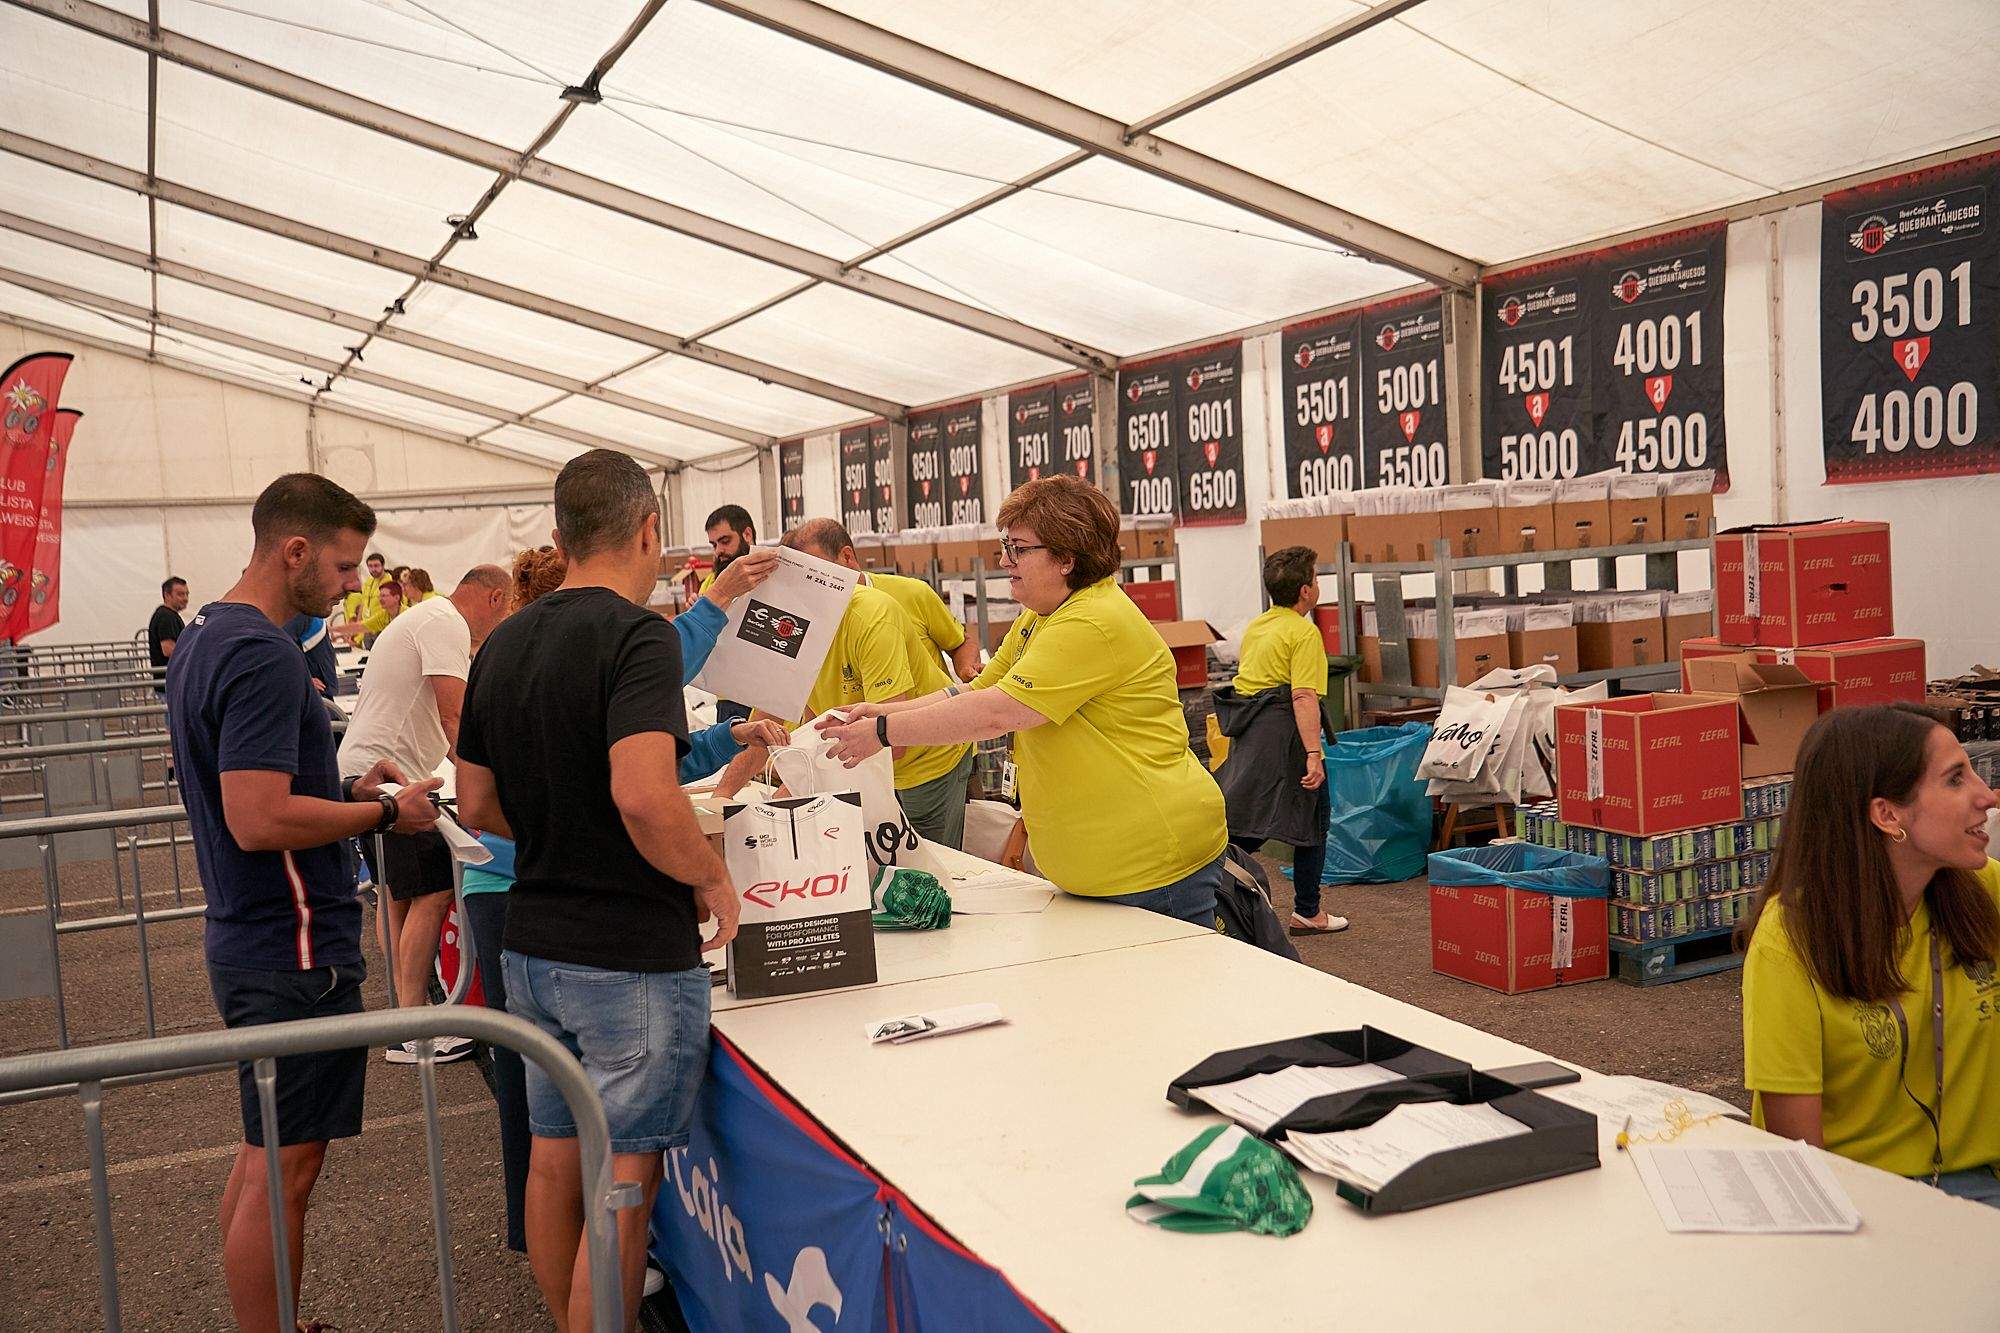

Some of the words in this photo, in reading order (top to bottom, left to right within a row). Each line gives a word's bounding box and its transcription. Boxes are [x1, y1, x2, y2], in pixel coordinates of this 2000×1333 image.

[1899, 204, 1980, 234] QUEBRANTAHUESOS
[1648, 265, 1706, 287] QUEBRANTAHUESOS
[1851, 261, 1971, 343] 3501
[1613, 310, 1701, 376] 4001
[1904, 340, 1919, 370] a
[1499, 335, 1573, 394] 4501
[1377, 359, 1439, 414] 5001
[1653, 379, 1665, 404] a
[1296, 376, 1349, 426] 5501
[1532, 396, 1542, 418] a
[1188, 398, 1234, 443] 6001
[1405, 413, 1414, 434] a
[1851, 381, 1978, 454] 4000
[1064, 424, 1094, 462] 700
[1128, 410, 1170, 452] 6501
[1320, 427, 1329, 446] a
[1615, 412, 1707, 474] 4500
[949, 444, 977, 477] 8001
[1018, 431, 1049, 468] 7501
[1501, 428, 1578, 481] 5000
[845, 462, 867, 491] 9501
[874, 458, 892, 487] 900
[912, 450, 939, 481] 8501
[1300, 454, 1353, 498] 6000
[1379, 442, 1445, 489] 5500
[0, 477, 26, 493] LUB
[784, 473, 803, 499] 1000
[1130, 476, 1172, 514] 7000
[1190, 468, 1237, 511] 6500
[0, 492, 34, 511] LISTA
[952, 498, 980, 525] 8500
[877, 506, 893, 534] 950
[914, 501, 940, 528] 9000
[1722, 561, 1744, 572] ZEFA
[1759, 562, 1785, 572] ZEFAL
[1803, 557, 1835, 571] ZEFAL
[1851, 553, 1882, 566] ZEFAL
[815, 577, 827, 587] 2XL
[829, 582, 845, 592] 2447
[1761, 615, 1787, 626] ZEFAL
[1806, 612, 1837, 625] ZEFAL
[1853, 607, 1883, 620] ZEFAL
[1843, 677, 1873, 690] ZEFAL
[1889, 671, 1917, 684] ZEFAL
[1564, 733, 1586, 744] ZEFA
[1602, 738, 1630, 750] ZEFAL
[1650, 735, 1683, 750] ZEFAL
[1700, 728, 1729, 742] ZEFAL
[1567, 789, 1589, 802] ZEFA
[1605, 795, 1632, 808] ZEFAL
[1653, 794, 1684, 808] ZEFAL
[1701, 786, 1731, 800] ZEFAL
[1743, 860, 1751, 884] AMBAR
[1615, 872, 1624, 897] AMBAR
[1648, 878, 1657, 903] AMBAR
[1473, 893, 1499, 909] ZEFAL
[1523, 896, 1552, 910] ZEFA
[765, 921, 804, 932] PRODUCTS
[804, 917, 839, 927] DESIGNED
[1560, 902, 1568, 933] ZEFAL
[1622, 910, 1630, 935] AMBAR
[1648, 913, 1656, 938] AMBAR
[1713, 901, 1721, 926] AMBAR
[766, 932, 782, 940] FOR
[783, 924, 840, 938] PERFORMANCE
[766, 939, 788, 948] WITH
[788, 937, 804, 946] PRO
[804, 932, 840, 943] ATHLETES
[1437, 939, 1462, 955] ZEFAL
[1475, 950, 1502, 967] ZEFAL
[1523, 954, 1552, 967] ZEFA
